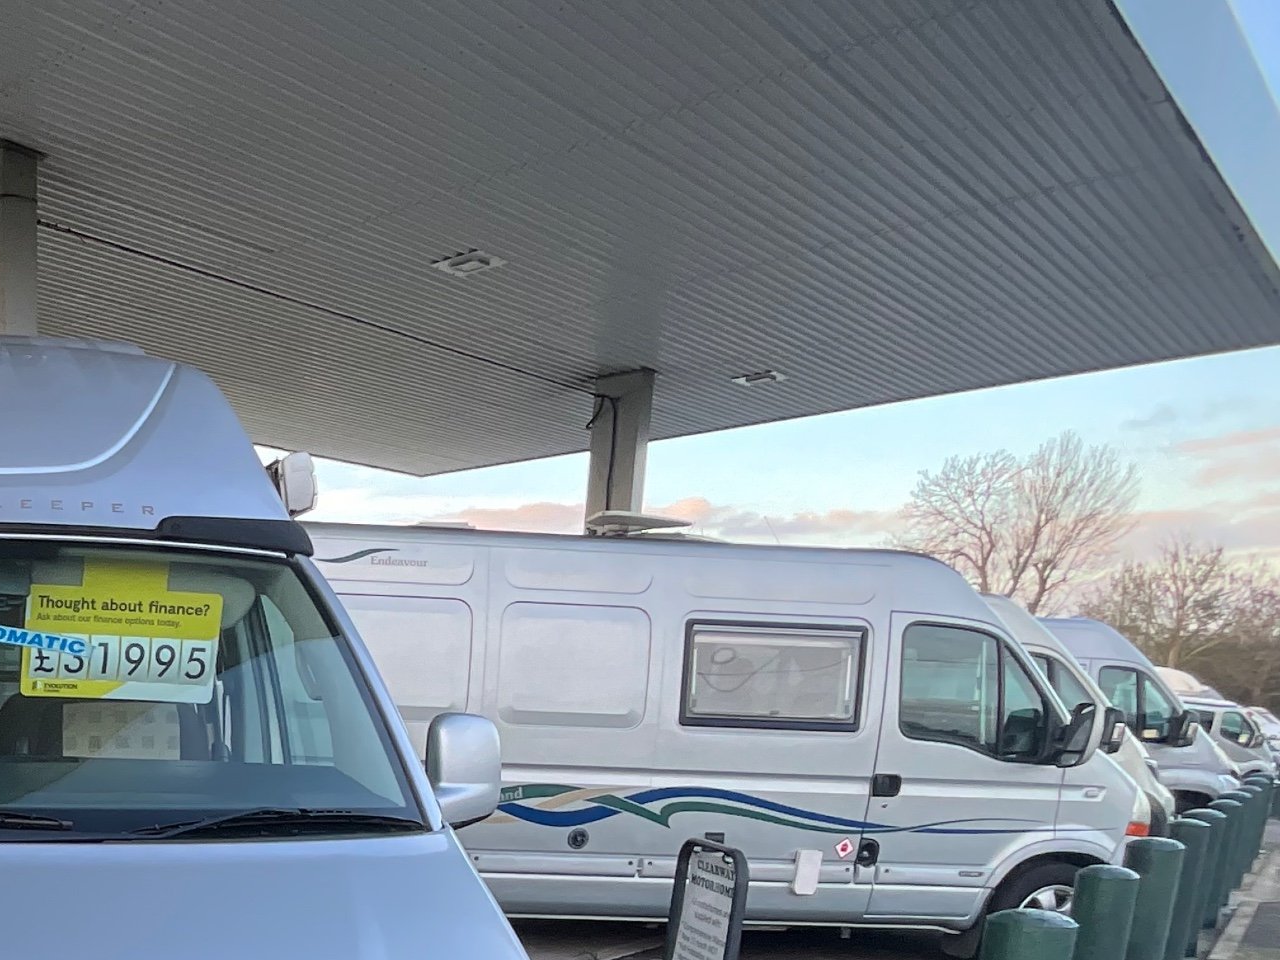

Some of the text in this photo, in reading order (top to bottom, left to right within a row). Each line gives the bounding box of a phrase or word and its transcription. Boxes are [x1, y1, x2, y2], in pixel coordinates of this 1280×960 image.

[370, 555, 428, 567] Endeavour
[38, 595, 210, 616] Thought about finance?
[36, 612, 51, 621] Ask
[53, 613, 76, 622] about
[93, 615, 123, 624] finance
[125, 616, 154, 627] options
